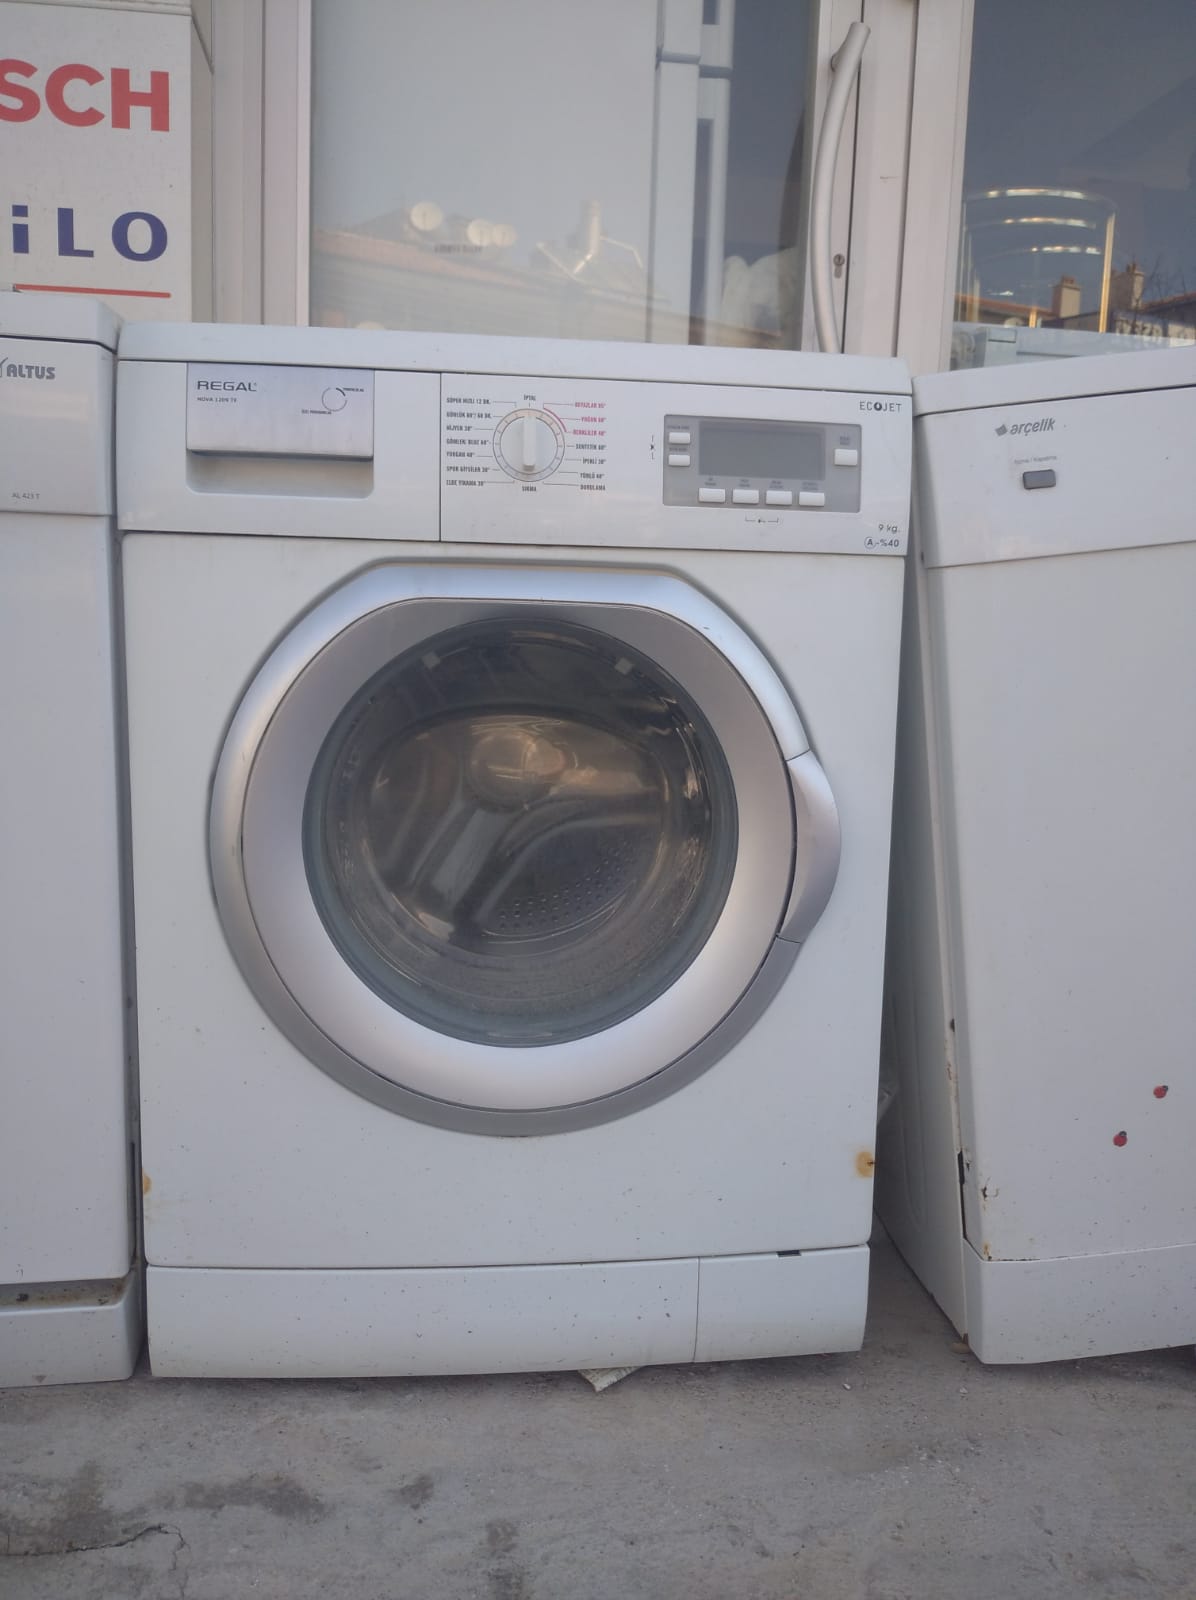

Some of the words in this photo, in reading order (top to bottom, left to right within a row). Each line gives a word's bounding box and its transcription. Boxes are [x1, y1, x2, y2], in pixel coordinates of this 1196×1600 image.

[0, 58, 170, 132] SCH
[6, 363, 56, 380] ALTUS
[197, 380, 257, 392] REGAL
[859, 401, 902, 413] ECOJET
[1009, 416, 1056, 436] arçelik
